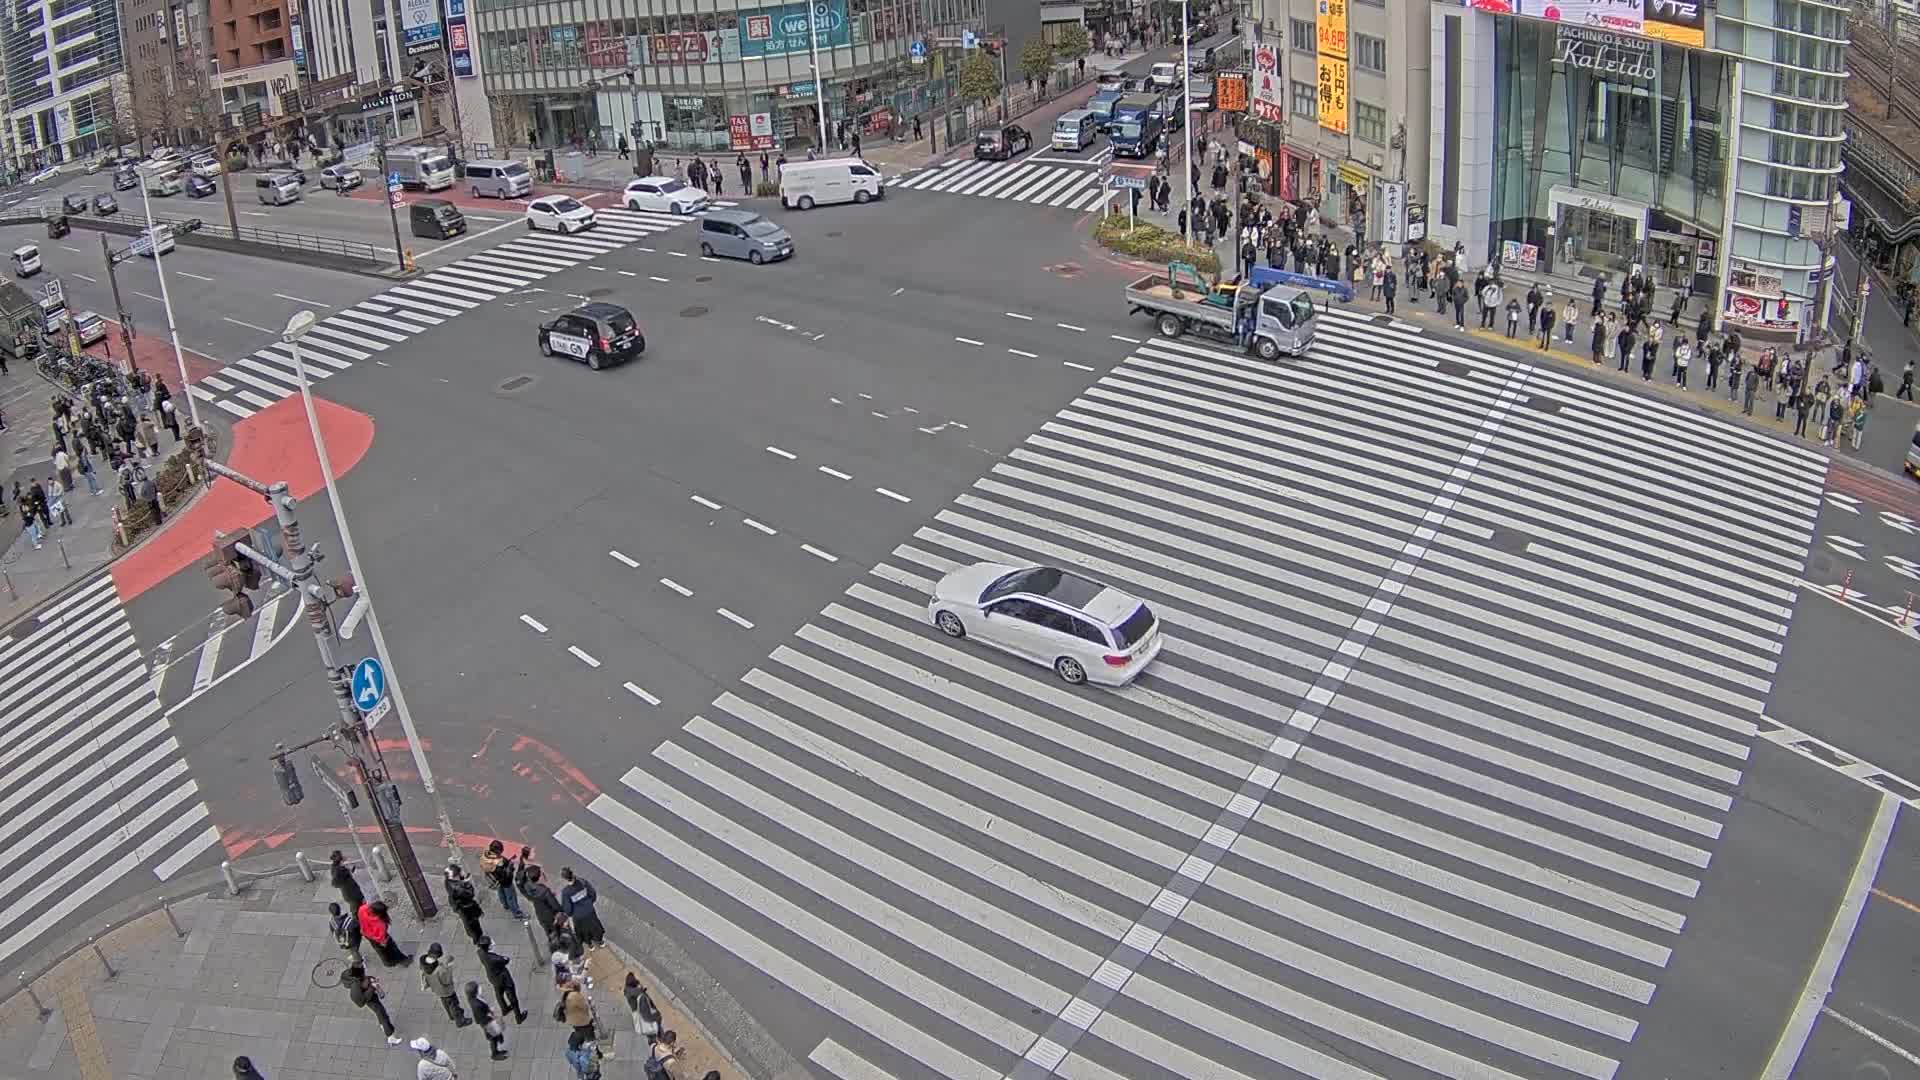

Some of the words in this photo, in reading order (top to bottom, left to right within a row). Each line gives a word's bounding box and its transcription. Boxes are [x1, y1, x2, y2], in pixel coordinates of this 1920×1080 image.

[765, 34, 828, 51] 処方せん付
[1556, 25, 1613, 44] PACHINKO
[1551, 38, 1656, 79] Kaleido
